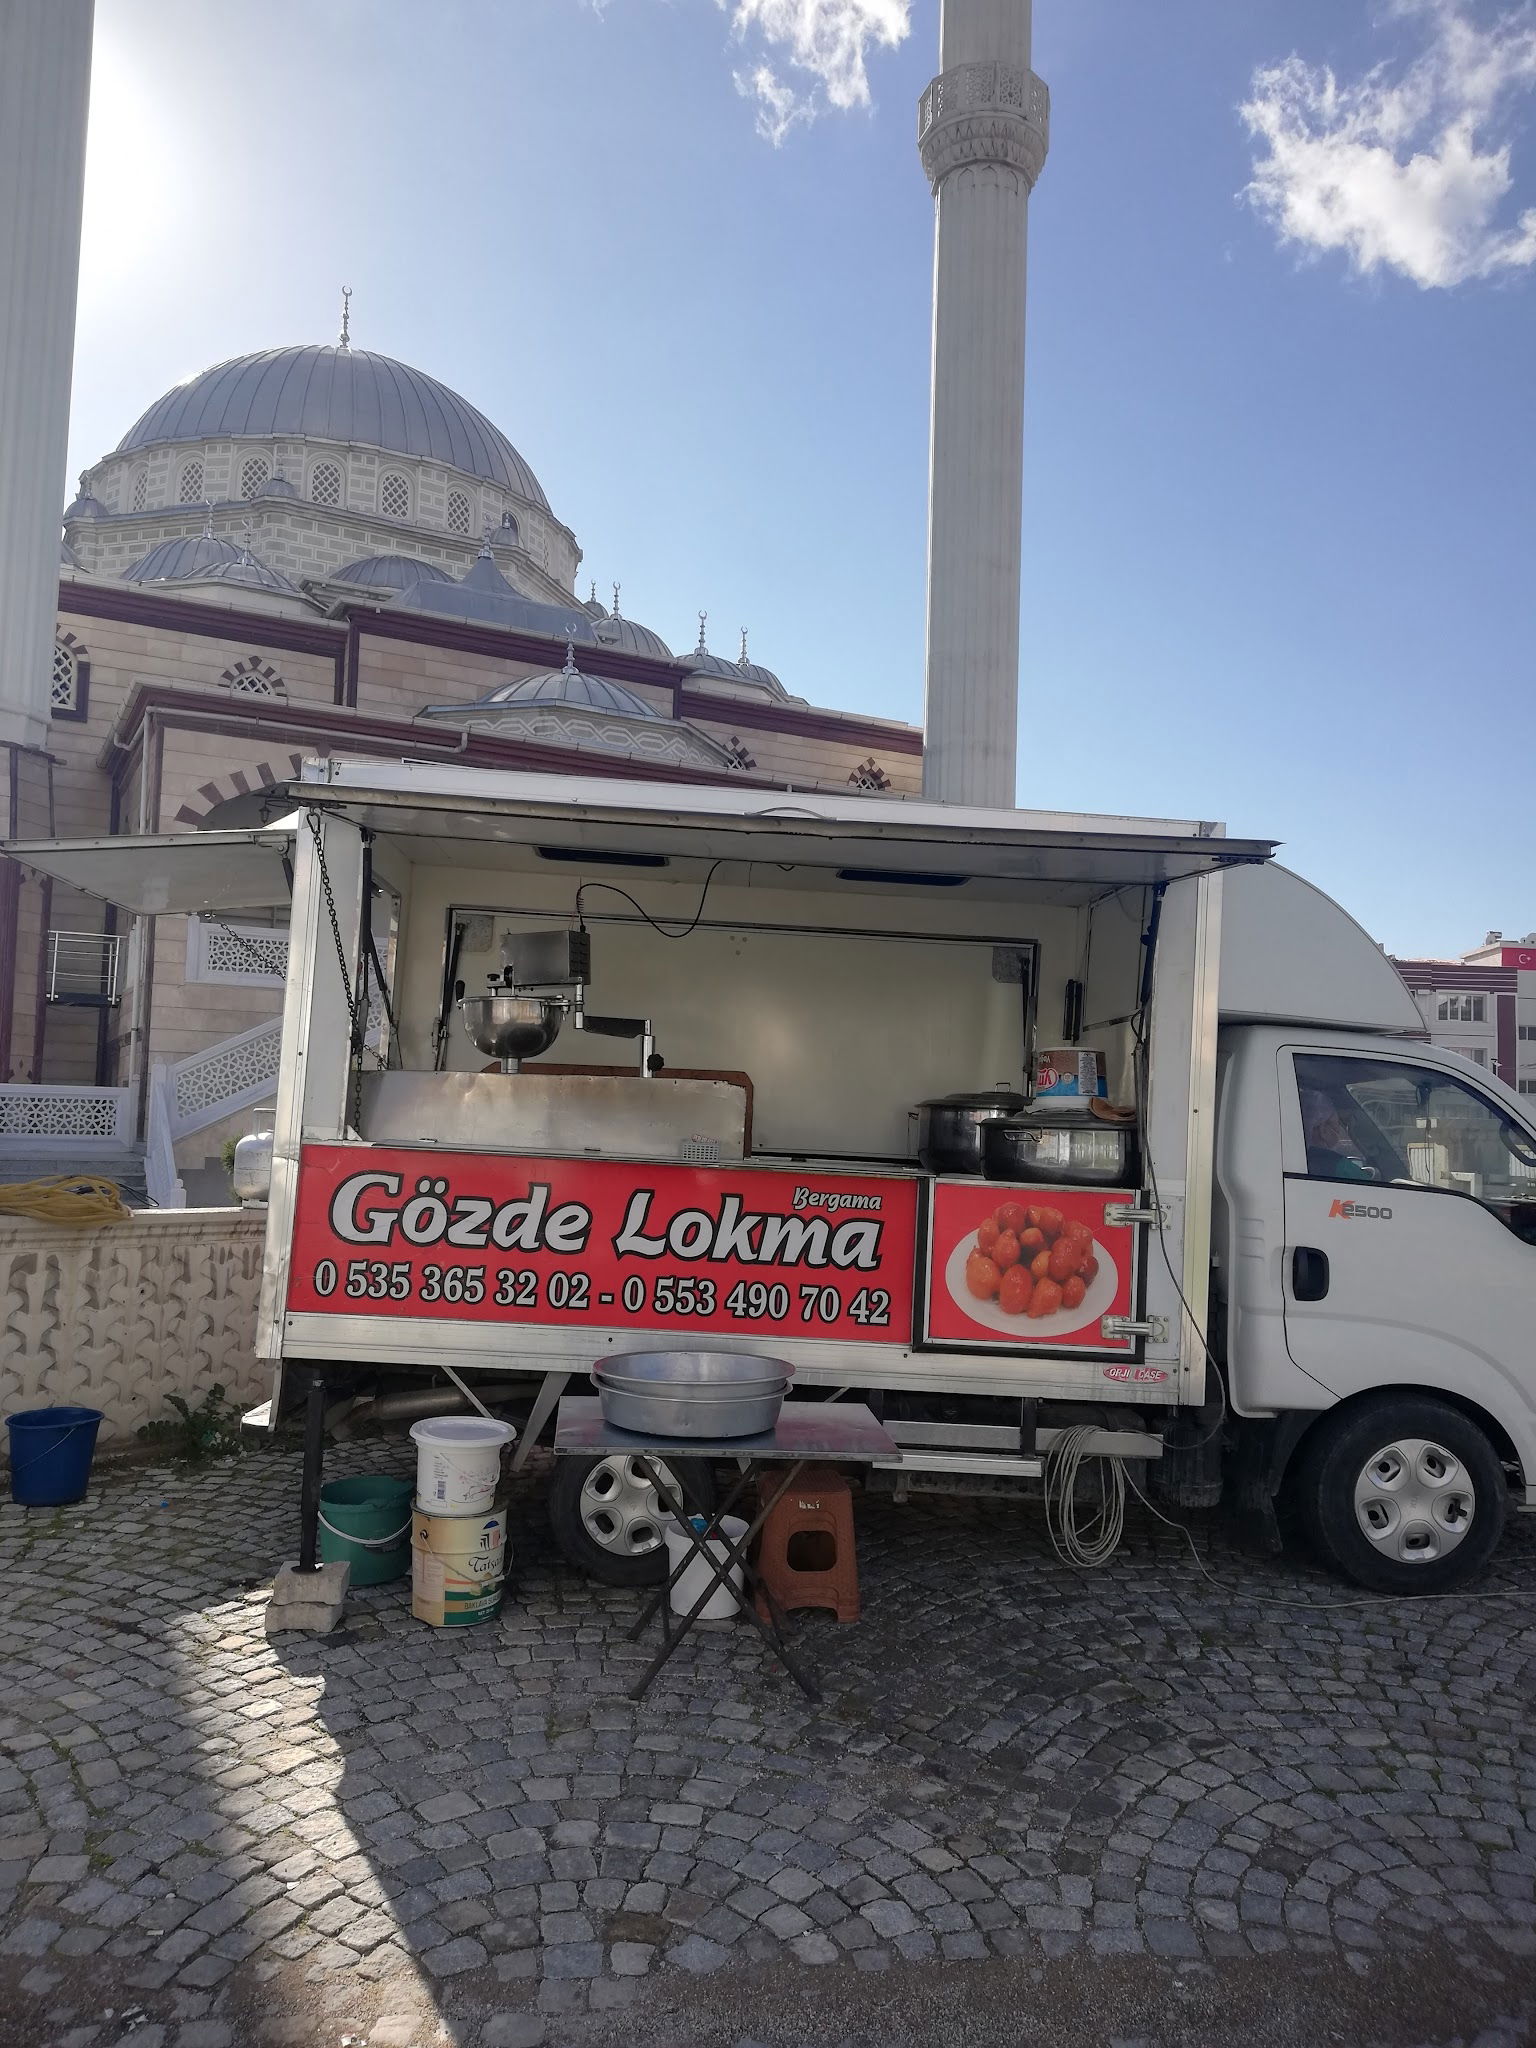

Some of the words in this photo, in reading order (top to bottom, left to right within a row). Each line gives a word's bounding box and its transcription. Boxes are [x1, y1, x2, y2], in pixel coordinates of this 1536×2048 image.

[329, 1170, 593, 1255] Gözde
[611, 1189, 884, 1271] Lokma
[792, 1186, 883, 1213] Bergama
[314, 1259, 338, 1297] 0
[346, 1259, 412, 1300] 535
[420, 1264, 486, 1304] 365
[495, 1268, 538, 1307] 32
[548, 1271, 591, 1310] 02
[622, 1274, 646, 1313] 0
[653, 1275, 717, 1316] 553
[725, 1280, 789, 1320] 490
[799, 1285, 842, 1322] 70
[848, 1288, 891, 1327] 42
